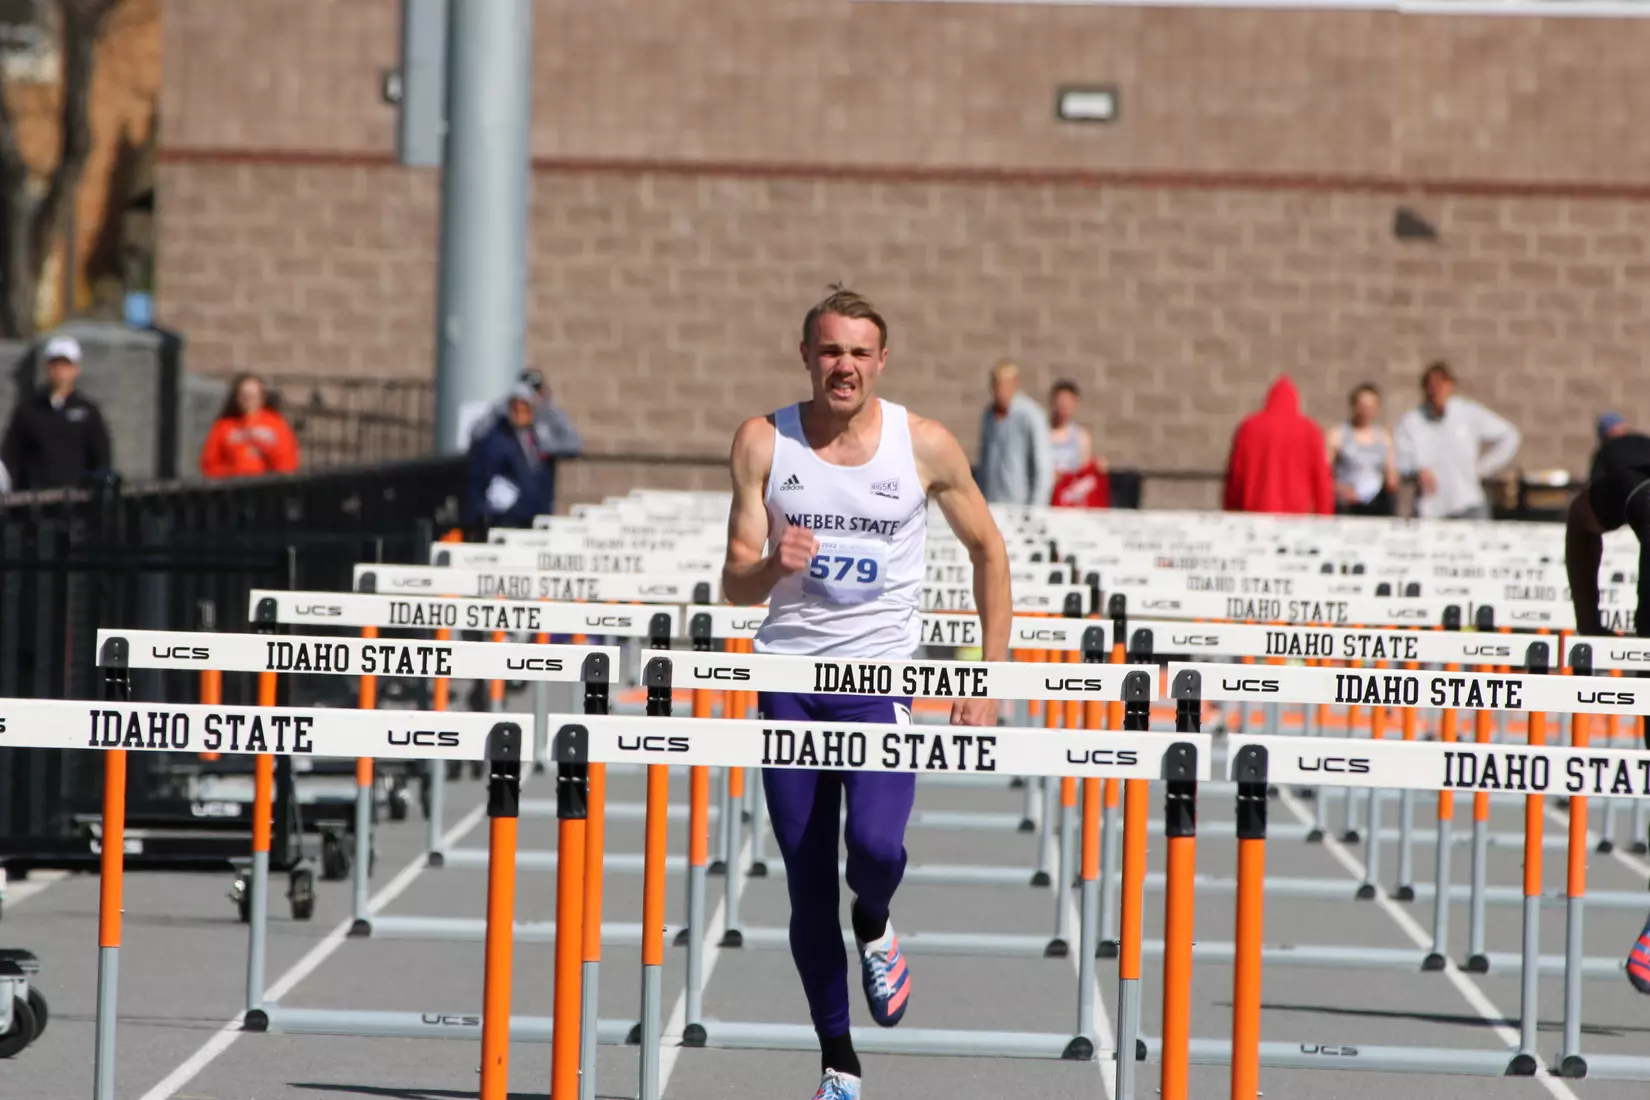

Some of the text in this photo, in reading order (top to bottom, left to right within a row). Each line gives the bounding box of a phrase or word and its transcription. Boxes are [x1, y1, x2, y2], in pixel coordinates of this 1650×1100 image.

[785, 513, 900, 536] WEBER STATE
[810, 554, 878, 583] 579
[926, 566, 965, 583] TATE
[477, 574, 599, 599] IDAHO STATE
[923, 588, 969, 611] TATE
[1143, 601, 1180, 609] UCS
[296, 606, 341, 616] UCS
[390, 602, 540, 629] IDAHO STATE
[1227, 598, 1348, 622] IDAHO STATE
[1389, 610, 1427, 618] UCS
[1512, 612, 1550, 620] UCS
[586, 617, 631, 627] UCS
[732, 620, 763, 630] UC
[920, 620, 976, 645] TATE
[1021, 631, 1066, 640] UCS
[1173, 636, 1218, 645] UCS
[1266, 632, 1417, 659] IDAHO STATE
[153, 647, 209, 659] UCS
[267, 642, 451, 675] IDAHO STATE
[1464, 646, 1510, 656] UCS
[507, 659, 562, 671] UCS
[694, 667, 750, 680] UCS
[814, 663, 987, 696] IDAHO STATE
[1046, 679, 1101, 691] UCS
[1223, 679, 1279, 692] UCS
[1336, 675, 1522, 708] IDAHO STATE
[1578, 692, 1634, 704] UCS
[89, 710, 313, 752] IDAHO STATE
[388, 731, 459, 746] UCS
[618, 736, 689, 752] UCS
[762, 729, 996, 771] IDAHO STATE
[1067, 750, 1137, 765] UCS
[1299, 757, 1369, 773] UCS
[1444, 752, 1650, 794] IDAHO STAT
[422, 1012, 480, 1025] UCS
[1300, 1044, 1358, 1056] UCS
